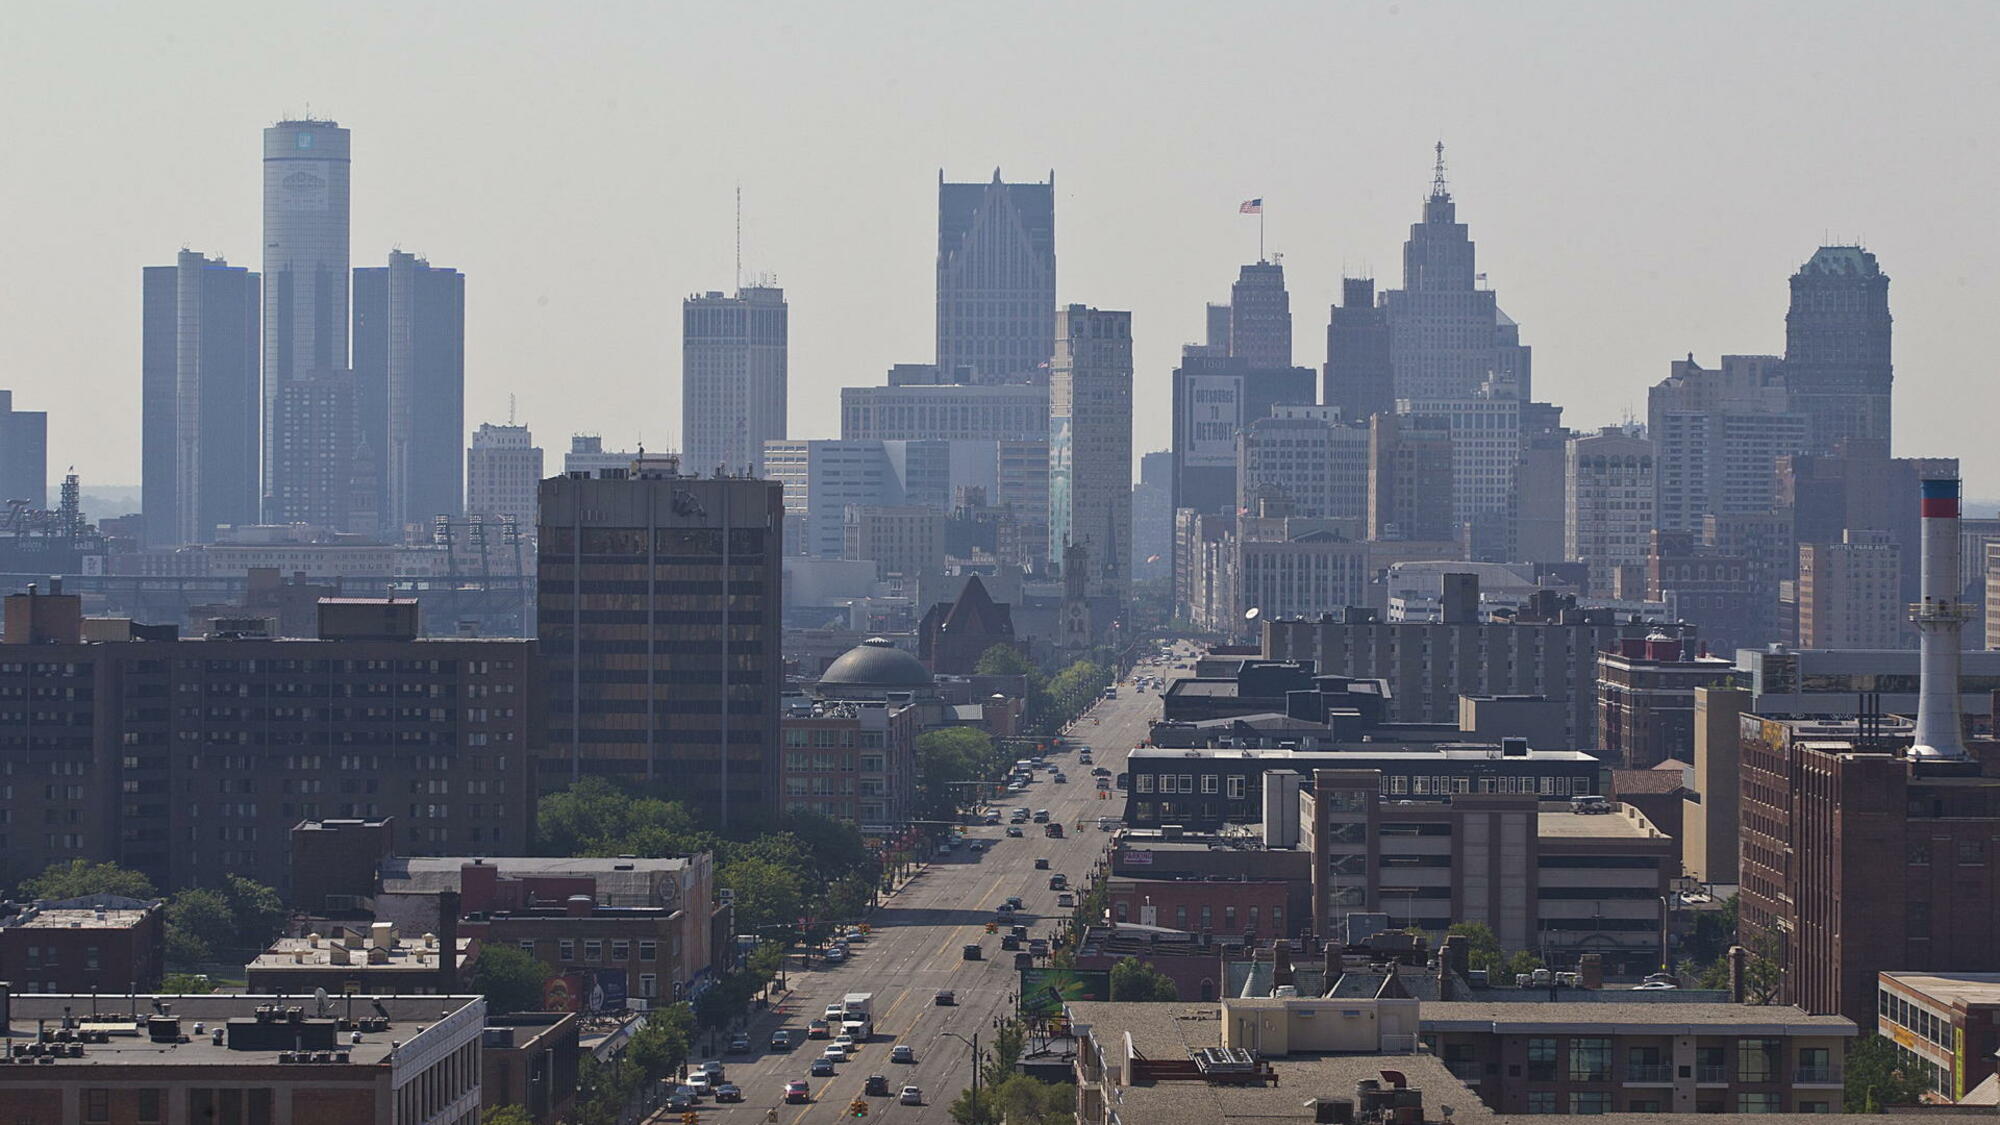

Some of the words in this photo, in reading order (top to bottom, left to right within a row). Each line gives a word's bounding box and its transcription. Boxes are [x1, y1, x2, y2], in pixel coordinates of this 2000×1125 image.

[1196, 390, 1234, 403] OUTSOURCE
[1210, 406, 1219, 420] TO
[1196, 422, 1233, 441] DETROIT
